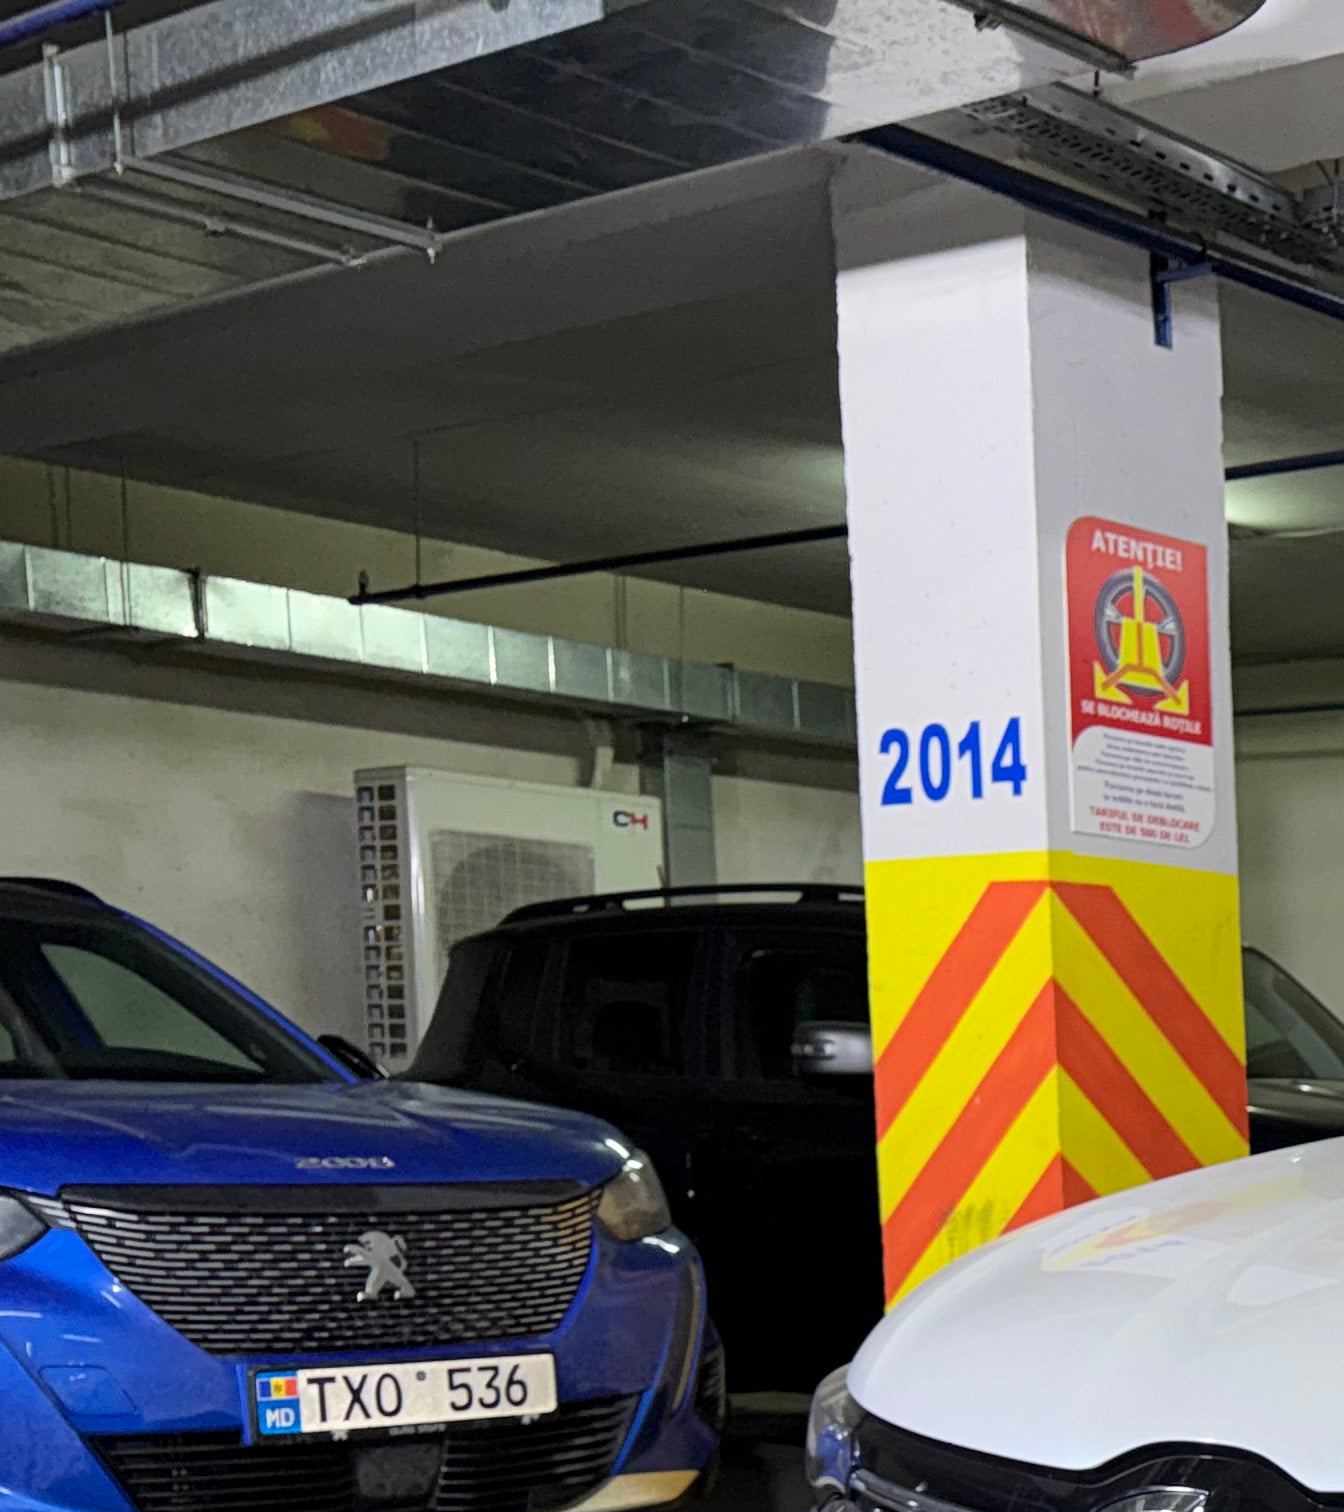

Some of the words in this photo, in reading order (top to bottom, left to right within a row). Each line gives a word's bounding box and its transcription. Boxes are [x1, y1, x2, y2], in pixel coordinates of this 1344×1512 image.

[1080, 700, 1095, 715] SE
[879, 717, 1027, 806] 2014
[307, 1372, 404, 1424] TXO
[447, 1363, 529, 1412] 536
[265, 1406, 296, 1430] MD
